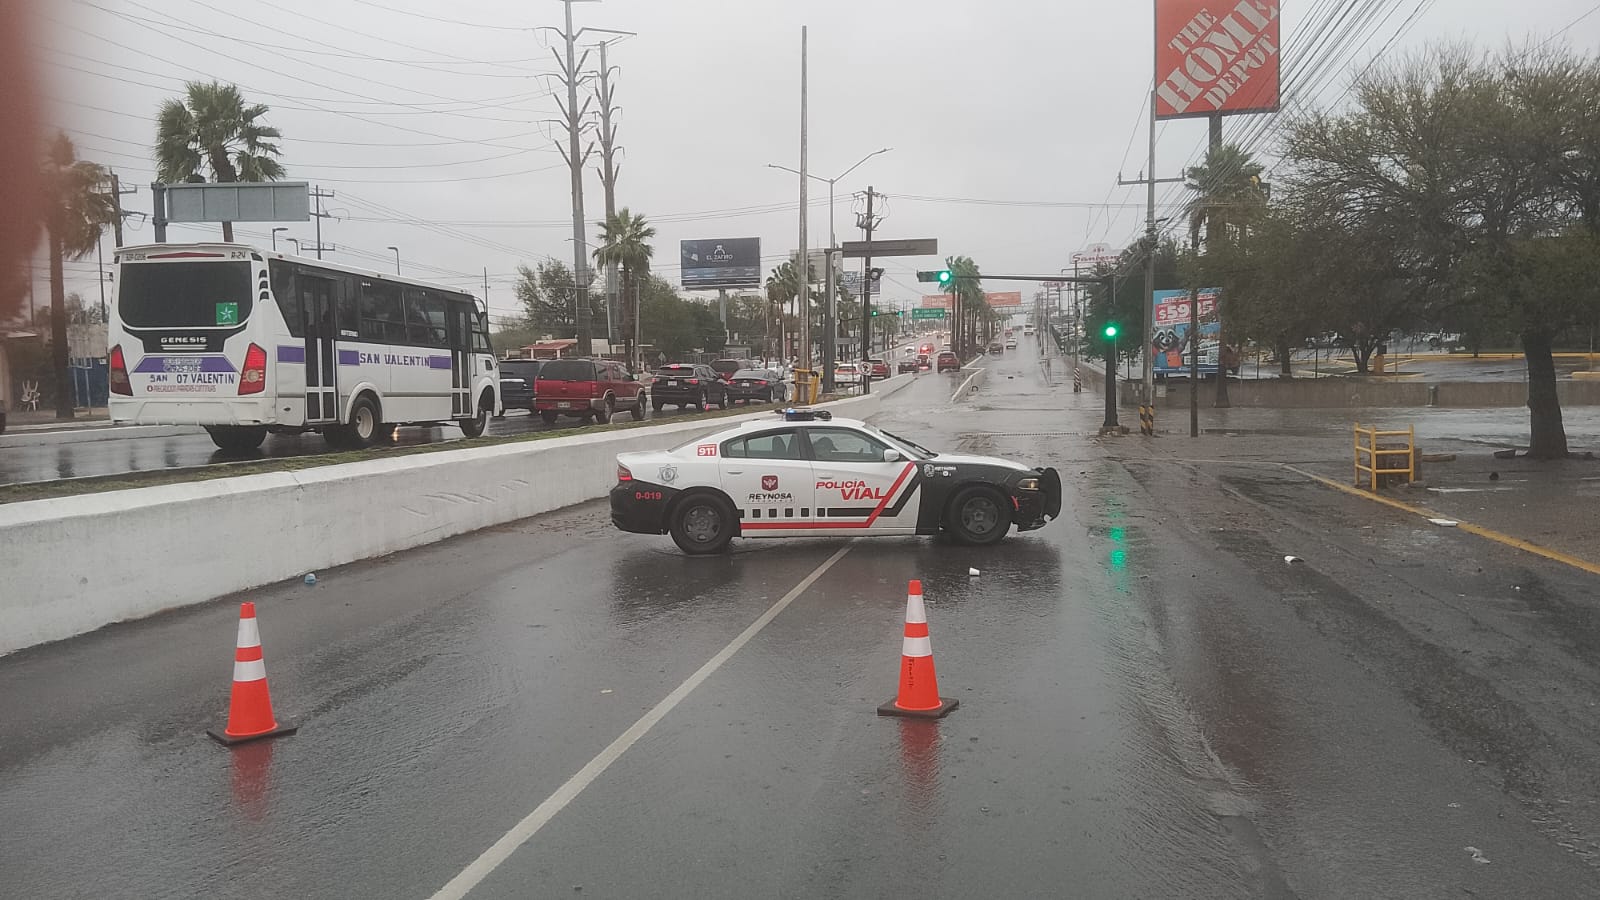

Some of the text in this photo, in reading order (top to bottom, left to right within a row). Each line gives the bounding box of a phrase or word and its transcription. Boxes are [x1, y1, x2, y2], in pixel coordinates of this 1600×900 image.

[1168, 8, 1217, 55] THE
[1157, 0, 1278, 113] HOME
[1203, 33, 1278, 110] DEPOT
[360, 352, 430, 367] SAN VALENTIN
[150, 374, 235, 384] SAN 07 VALENTIN
[698, 447, 716, 456] 911
[635, 491, 662, 500] 0-019
[749, 492, 792, 500] REYNOSA
[840, 487, 886, 500] VIAL
